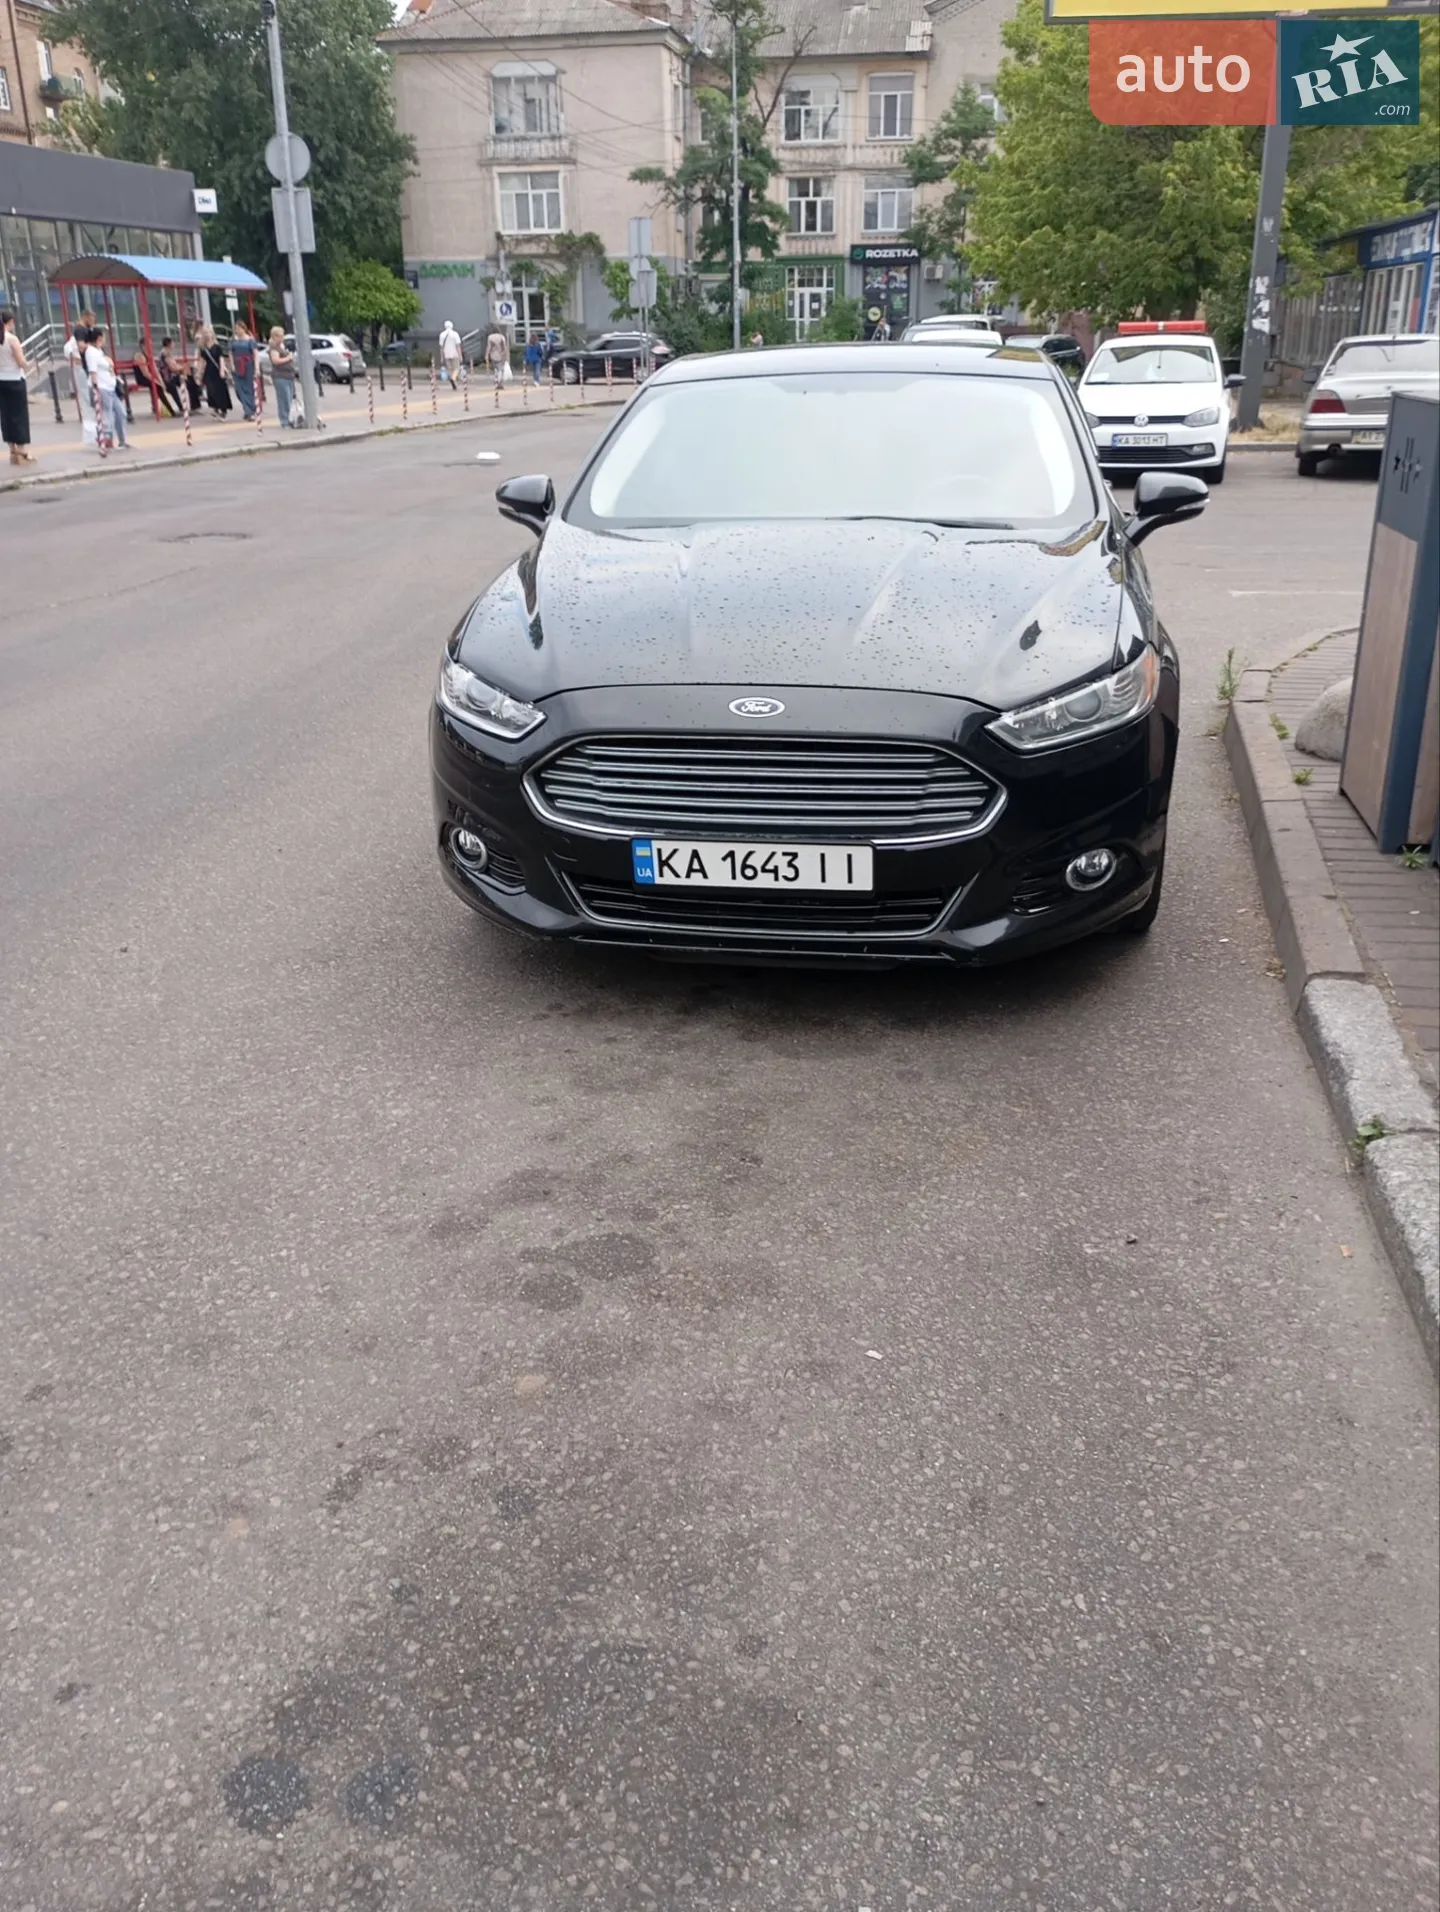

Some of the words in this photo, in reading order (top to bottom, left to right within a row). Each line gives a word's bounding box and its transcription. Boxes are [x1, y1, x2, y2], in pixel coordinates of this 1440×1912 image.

[865, 248, 919, 259] ROZETKA
[1118, 436, 1130, 445] KA
[741, 700, 772, 713] Ford
[656, 847, 709, 880] KA
[721, 849, 800, 883] 1643
[636, 867, 653, 878] UA
